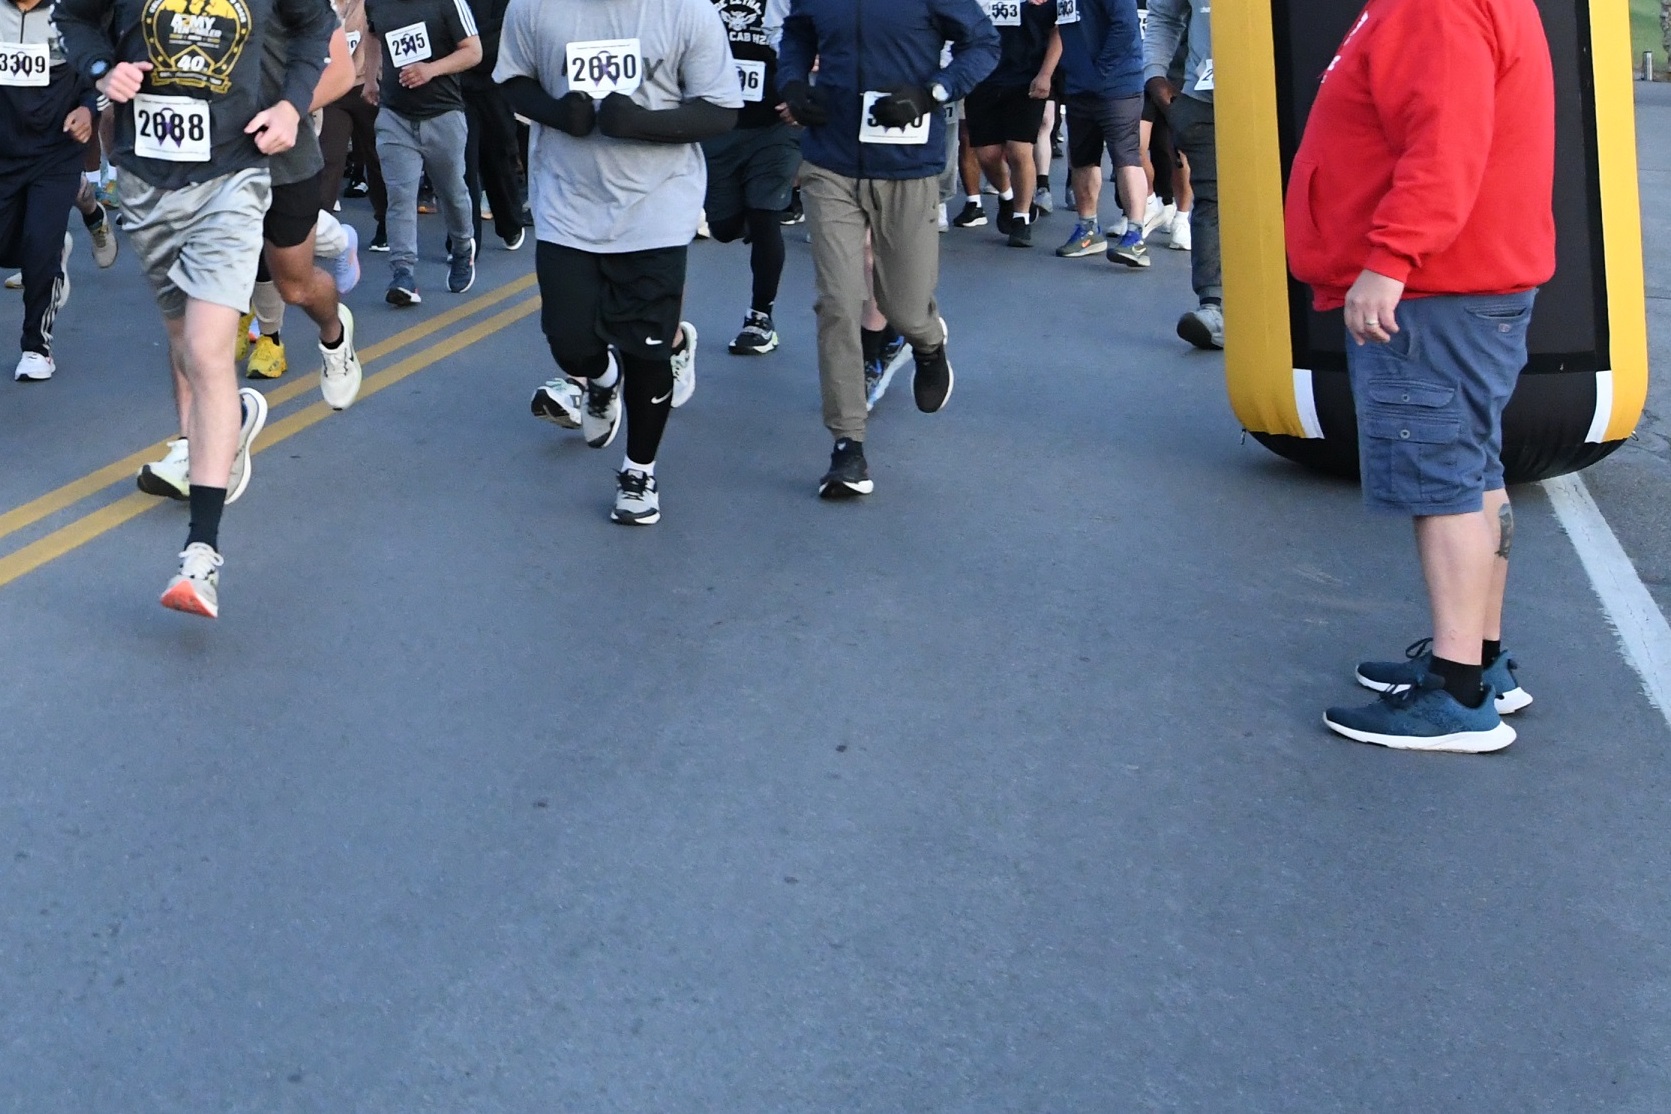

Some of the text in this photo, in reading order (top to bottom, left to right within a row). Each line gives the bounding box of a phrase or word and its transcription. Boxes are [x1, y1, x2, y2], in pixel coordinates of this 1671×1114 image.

[990, 4, 1018, 19] 553
[392, 33, 426, 56] 2515
[572, 54, 636, 82] 2650
[138, 109, 204, 141] 2688
